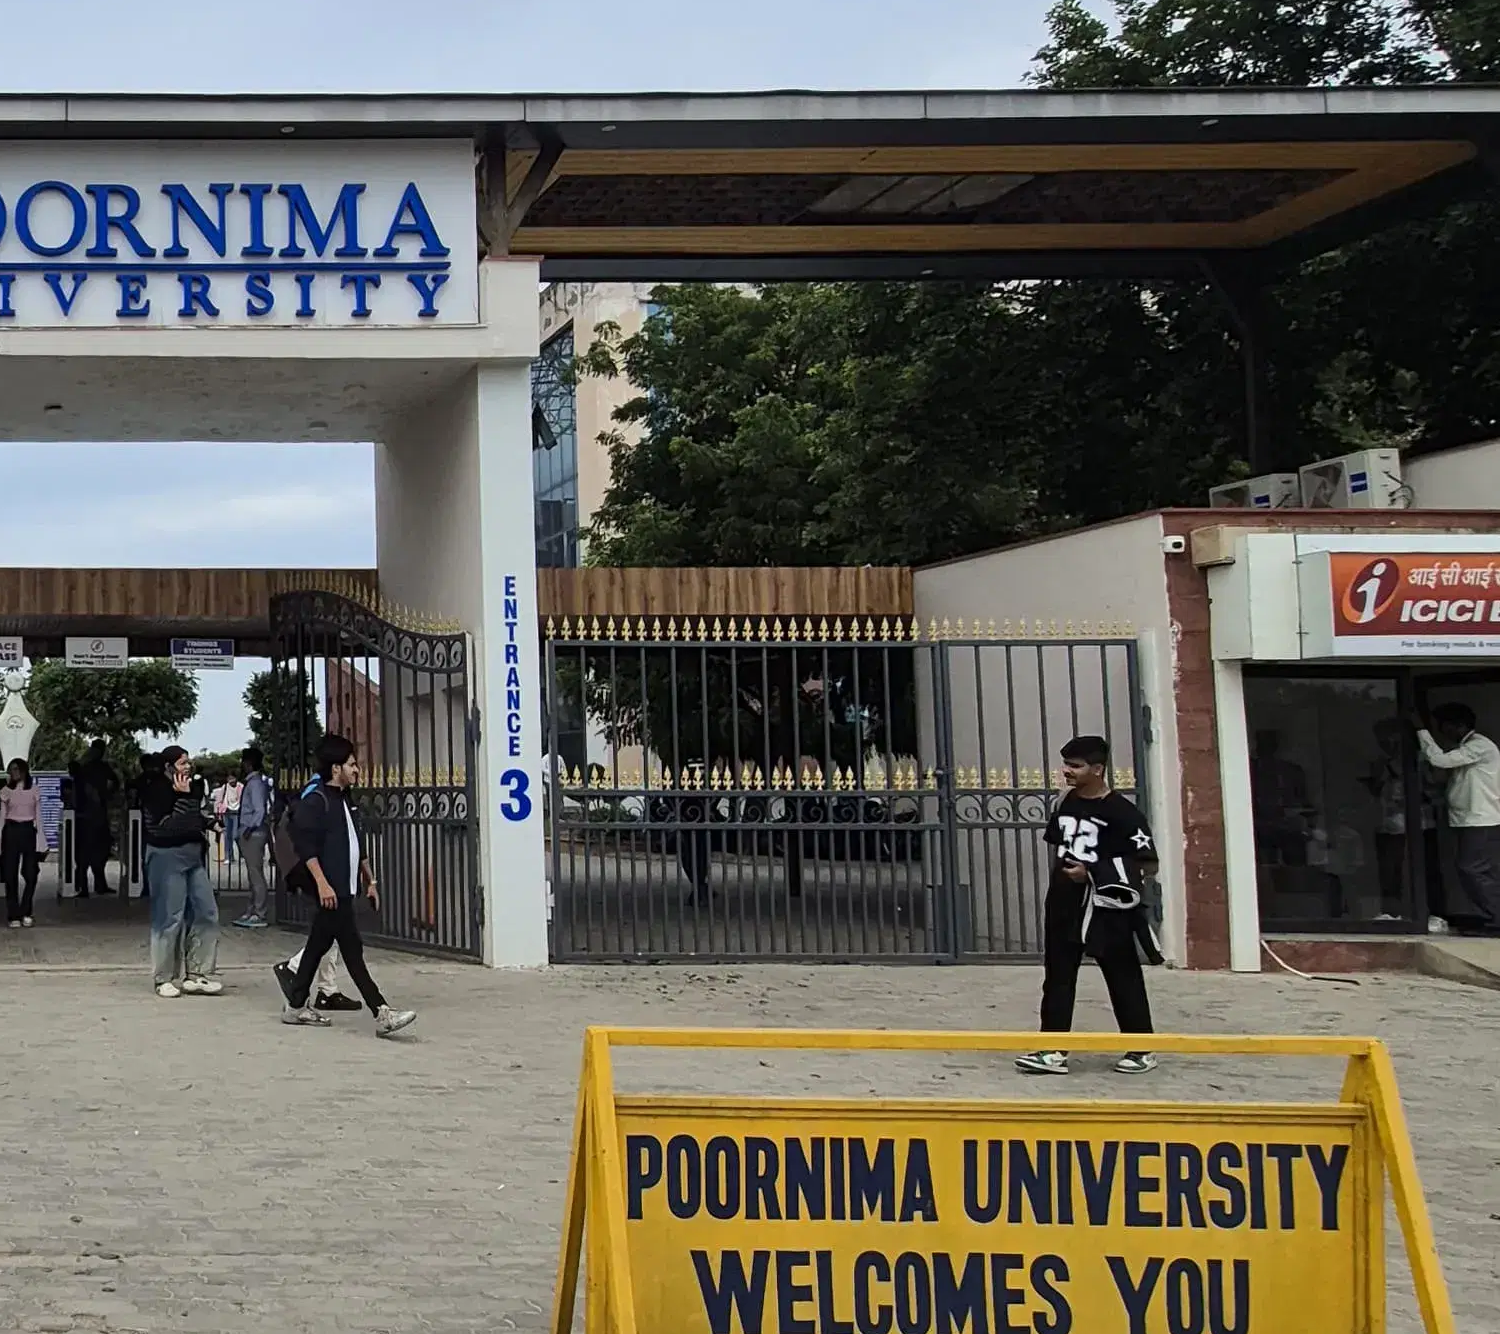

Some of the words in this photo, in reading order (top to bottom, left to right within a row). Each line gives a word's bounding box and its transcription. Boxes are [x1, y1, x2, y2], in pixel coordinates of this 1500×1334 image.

[1407, 562, 1442, 589] आई
[1441, 561, 1461, 586] सी
[1461, 562, 1495, 589] आई
[1400, 599, 1488, 623] ICICI
[504, 575, 521, 757] ENTRANCE
[500, 768, 532, 822] 3
[626, 1133, 939, 1223] POORNIMA
[962, 1137, 1351, 1233] UNIVERSITY
